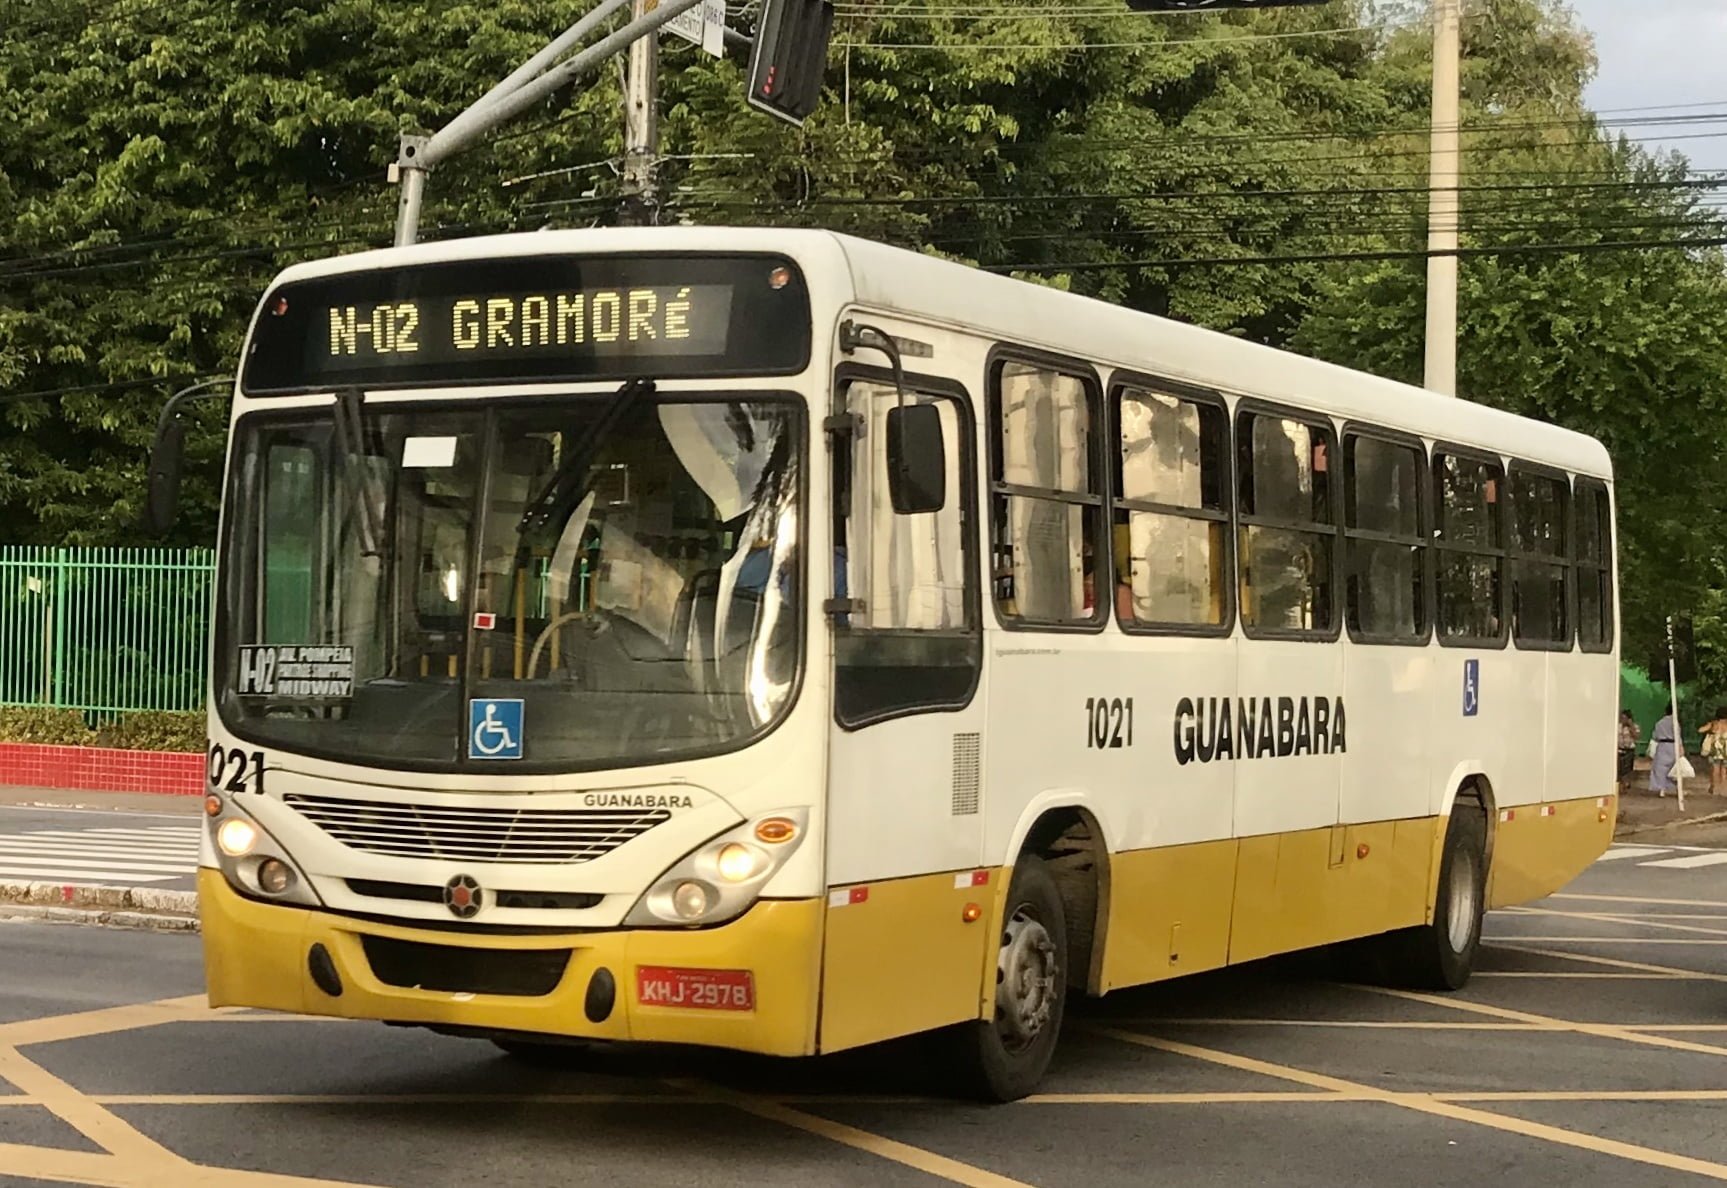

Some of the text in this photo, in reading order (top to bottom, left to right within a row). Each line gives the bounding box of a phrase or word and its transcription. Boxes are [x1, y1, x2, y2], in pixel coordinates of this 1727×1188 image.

[329, 287, 691, 356] N-02 GRAMORÉ
[239, 647, 276, 693] N-02
[278, 680, 351, 695] MIDWAY
[1085, 697, 1133, 750] 1021
[1173, 696, 1347, 766] GUANABARA
[206, 738, 264, 795] 021
[583, 794, 693, 808] GUANABARA
